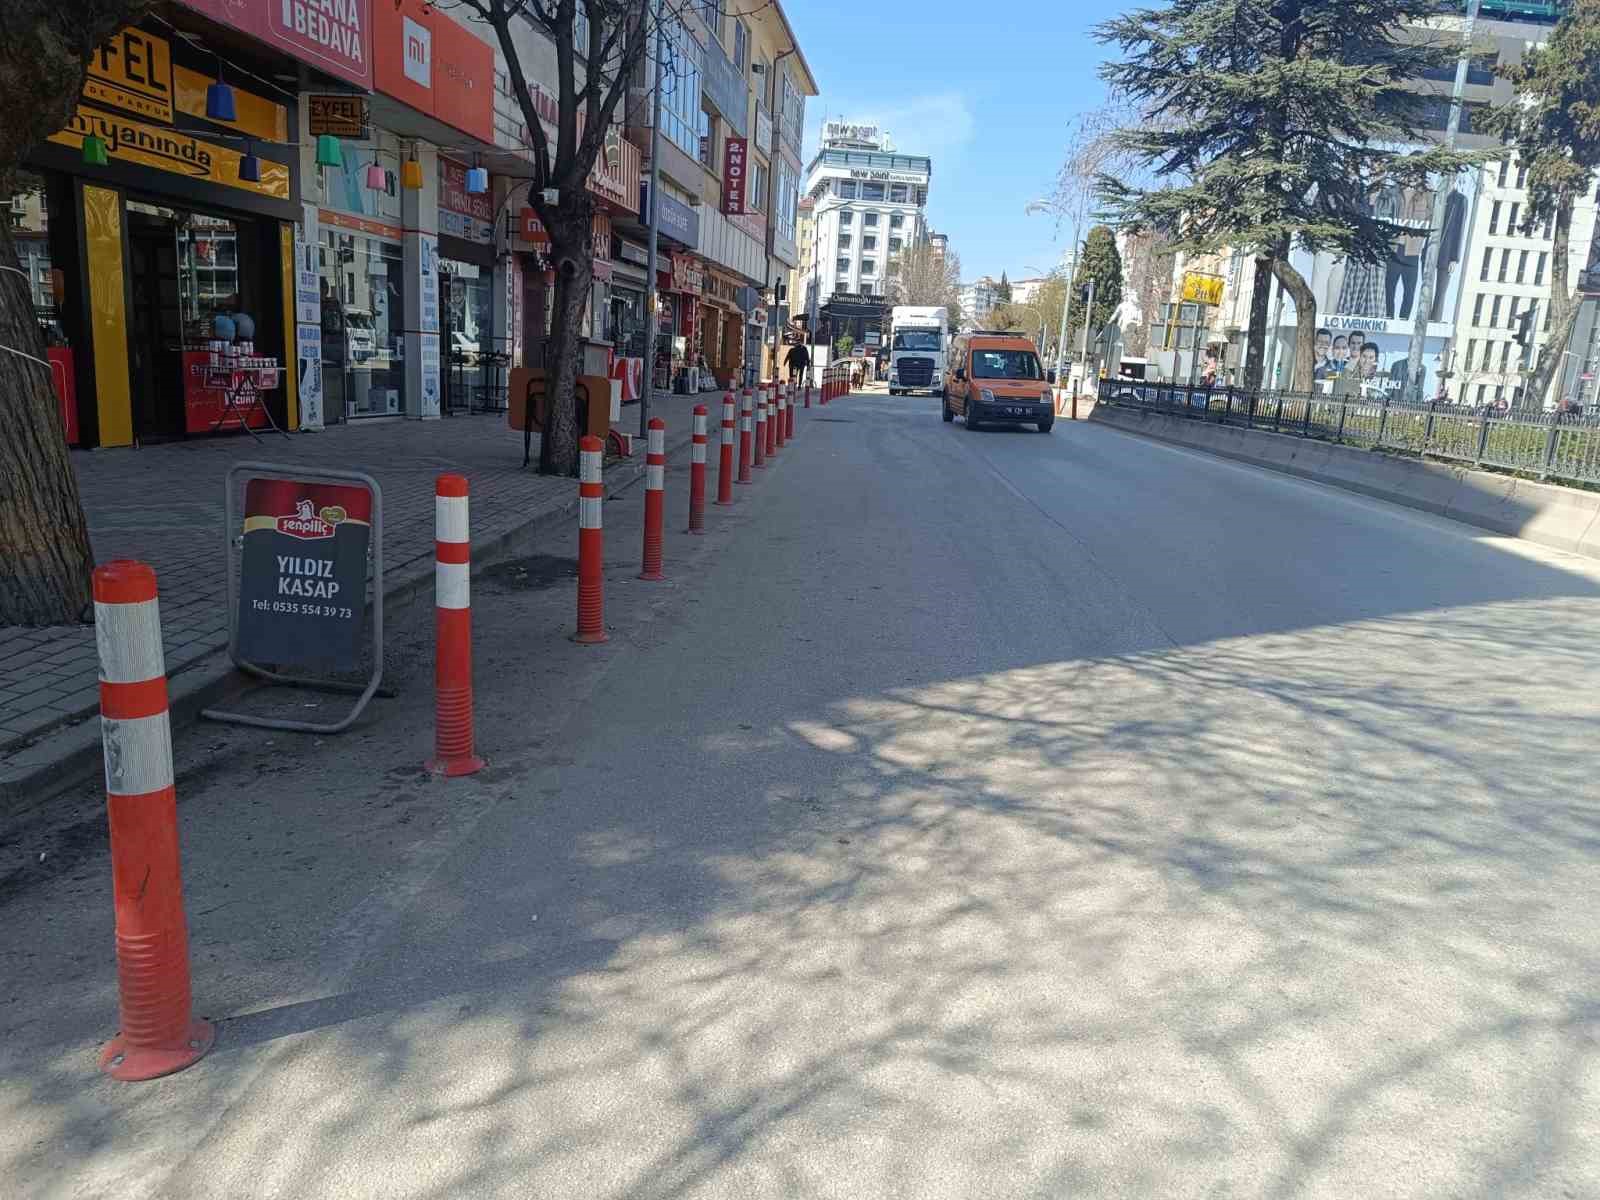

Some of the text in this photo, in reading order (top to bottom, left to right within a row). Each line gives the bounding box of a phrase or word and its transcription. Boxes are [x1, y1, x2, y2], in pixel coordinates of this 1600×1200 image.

[294, 2, 362, 65] BEDAVA
[100, 32, 167, 92] FEL
[728, 143, 744, 212] 2. NOTER
[1324, 316, 1387, 331] LC WAIKIKI
[277, 555, 334, 578] YILDIZ
[277, 577, 340, 599] KASAP
[252, 599, 352, 619] Tel: 0535 554 39 73
